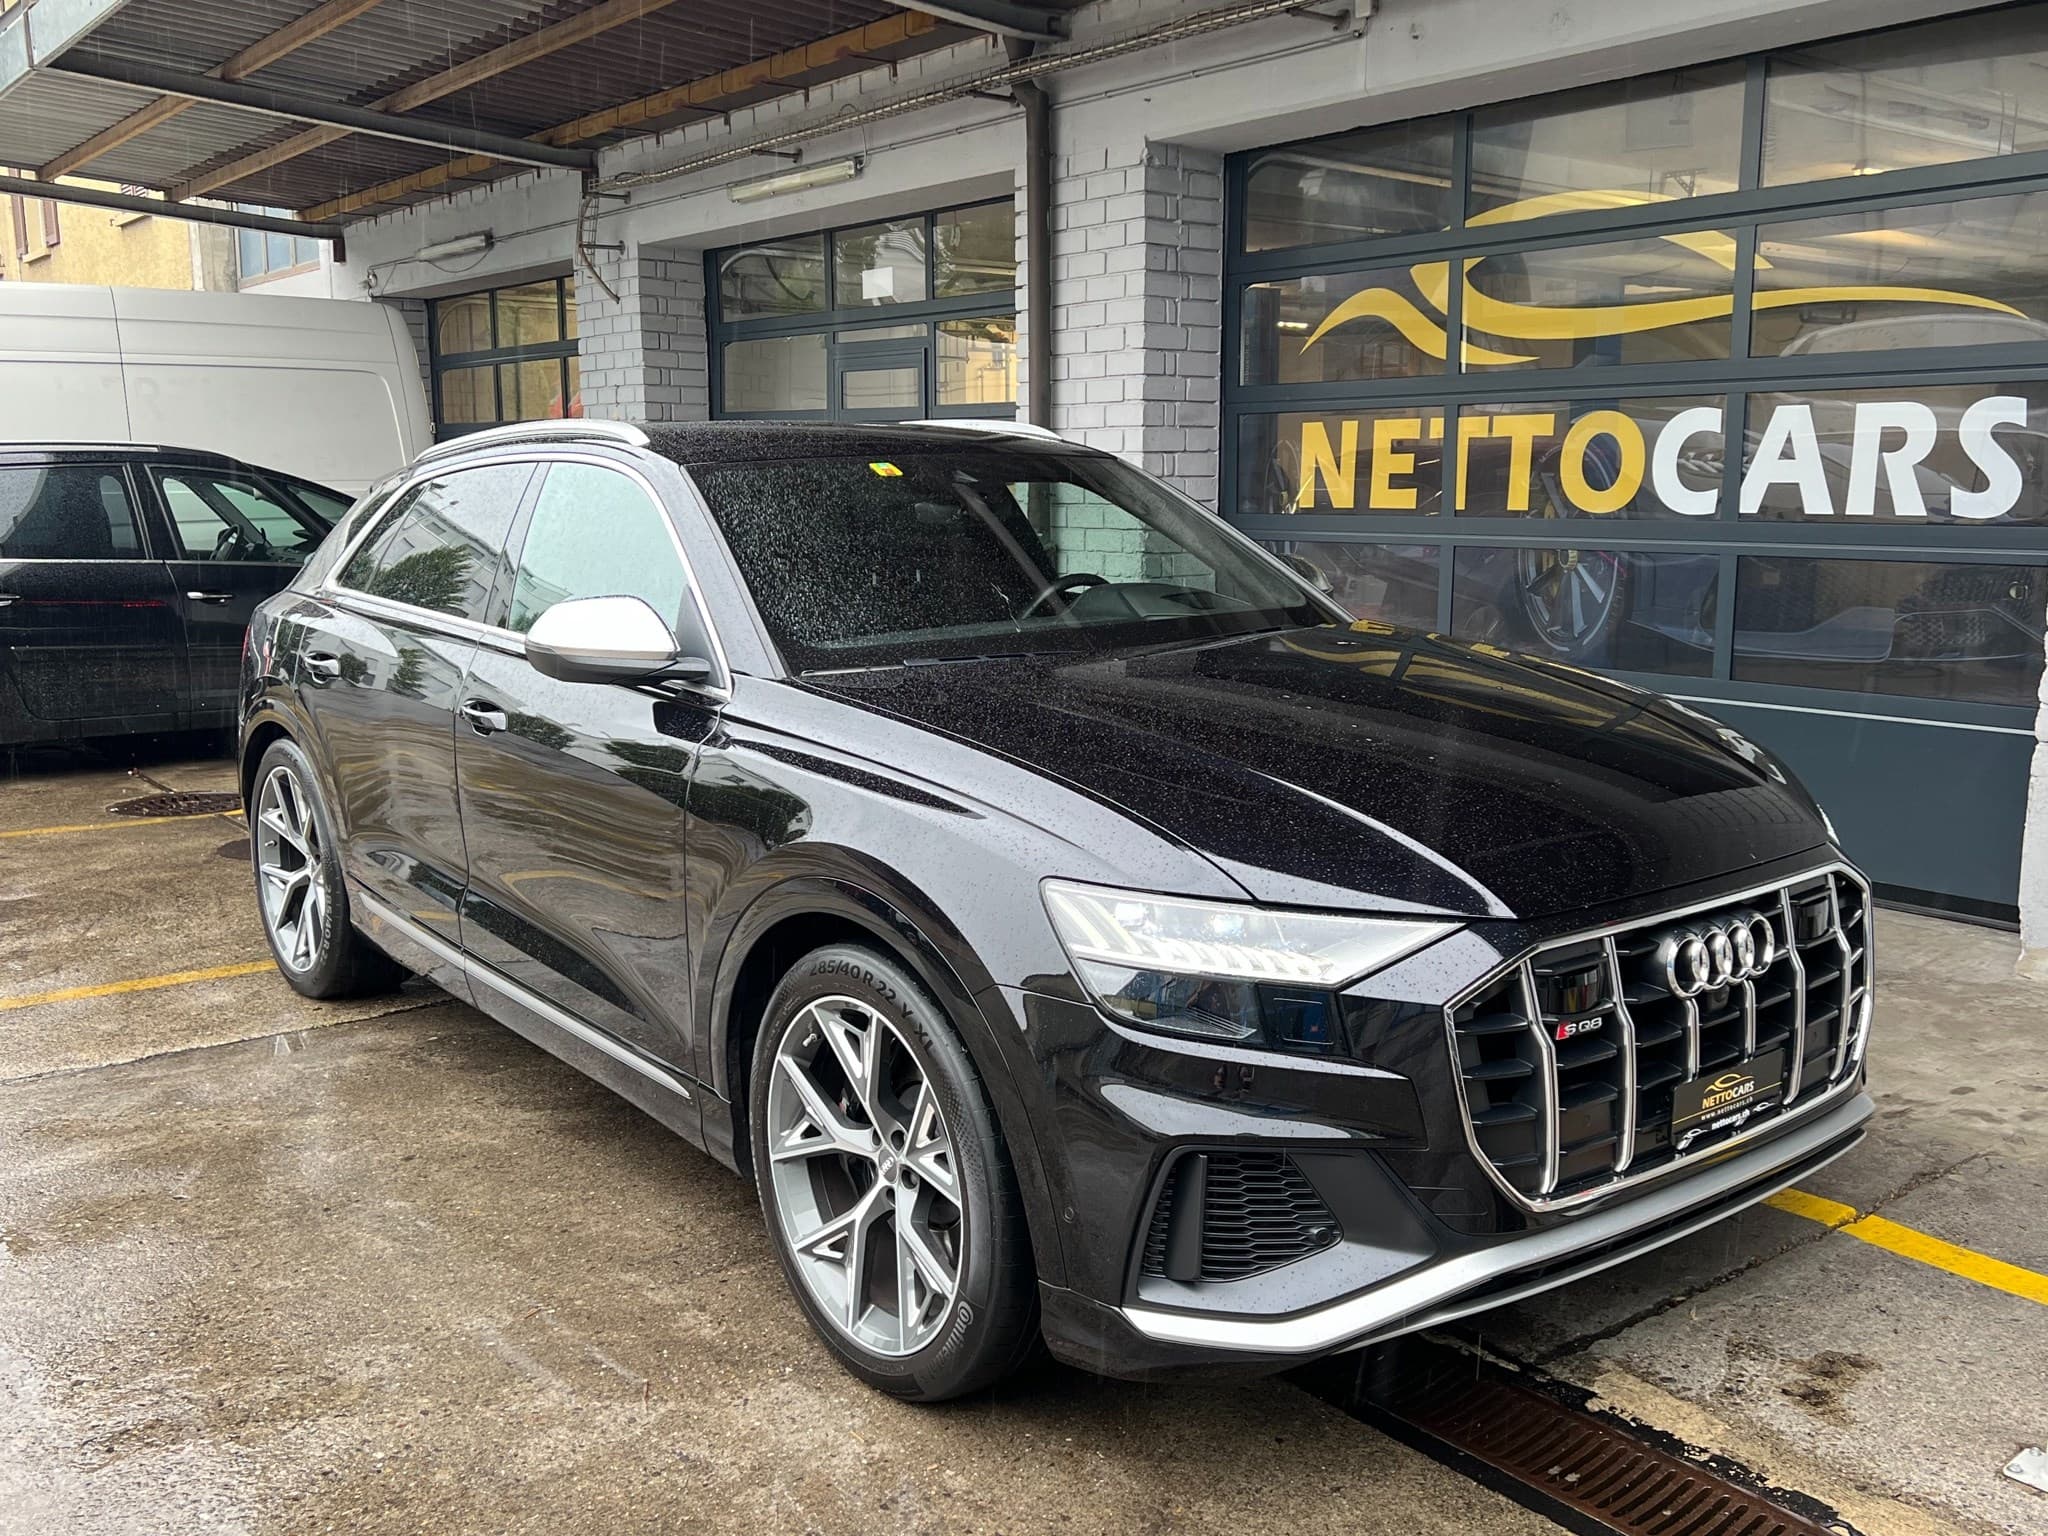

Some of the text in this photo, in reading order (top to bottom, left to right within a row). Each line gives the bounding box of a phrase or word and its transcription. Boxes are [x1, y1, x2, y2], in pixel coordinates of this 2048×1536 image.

[1299, 396, 2029, 518] NETTOCARS
[809, 959, 861, 979] 285/40
[862, 970, 874, 987] R
[875, 980, 897, 1005] 22
[1702, 1081, 1755, 1110] NETTOCARS
